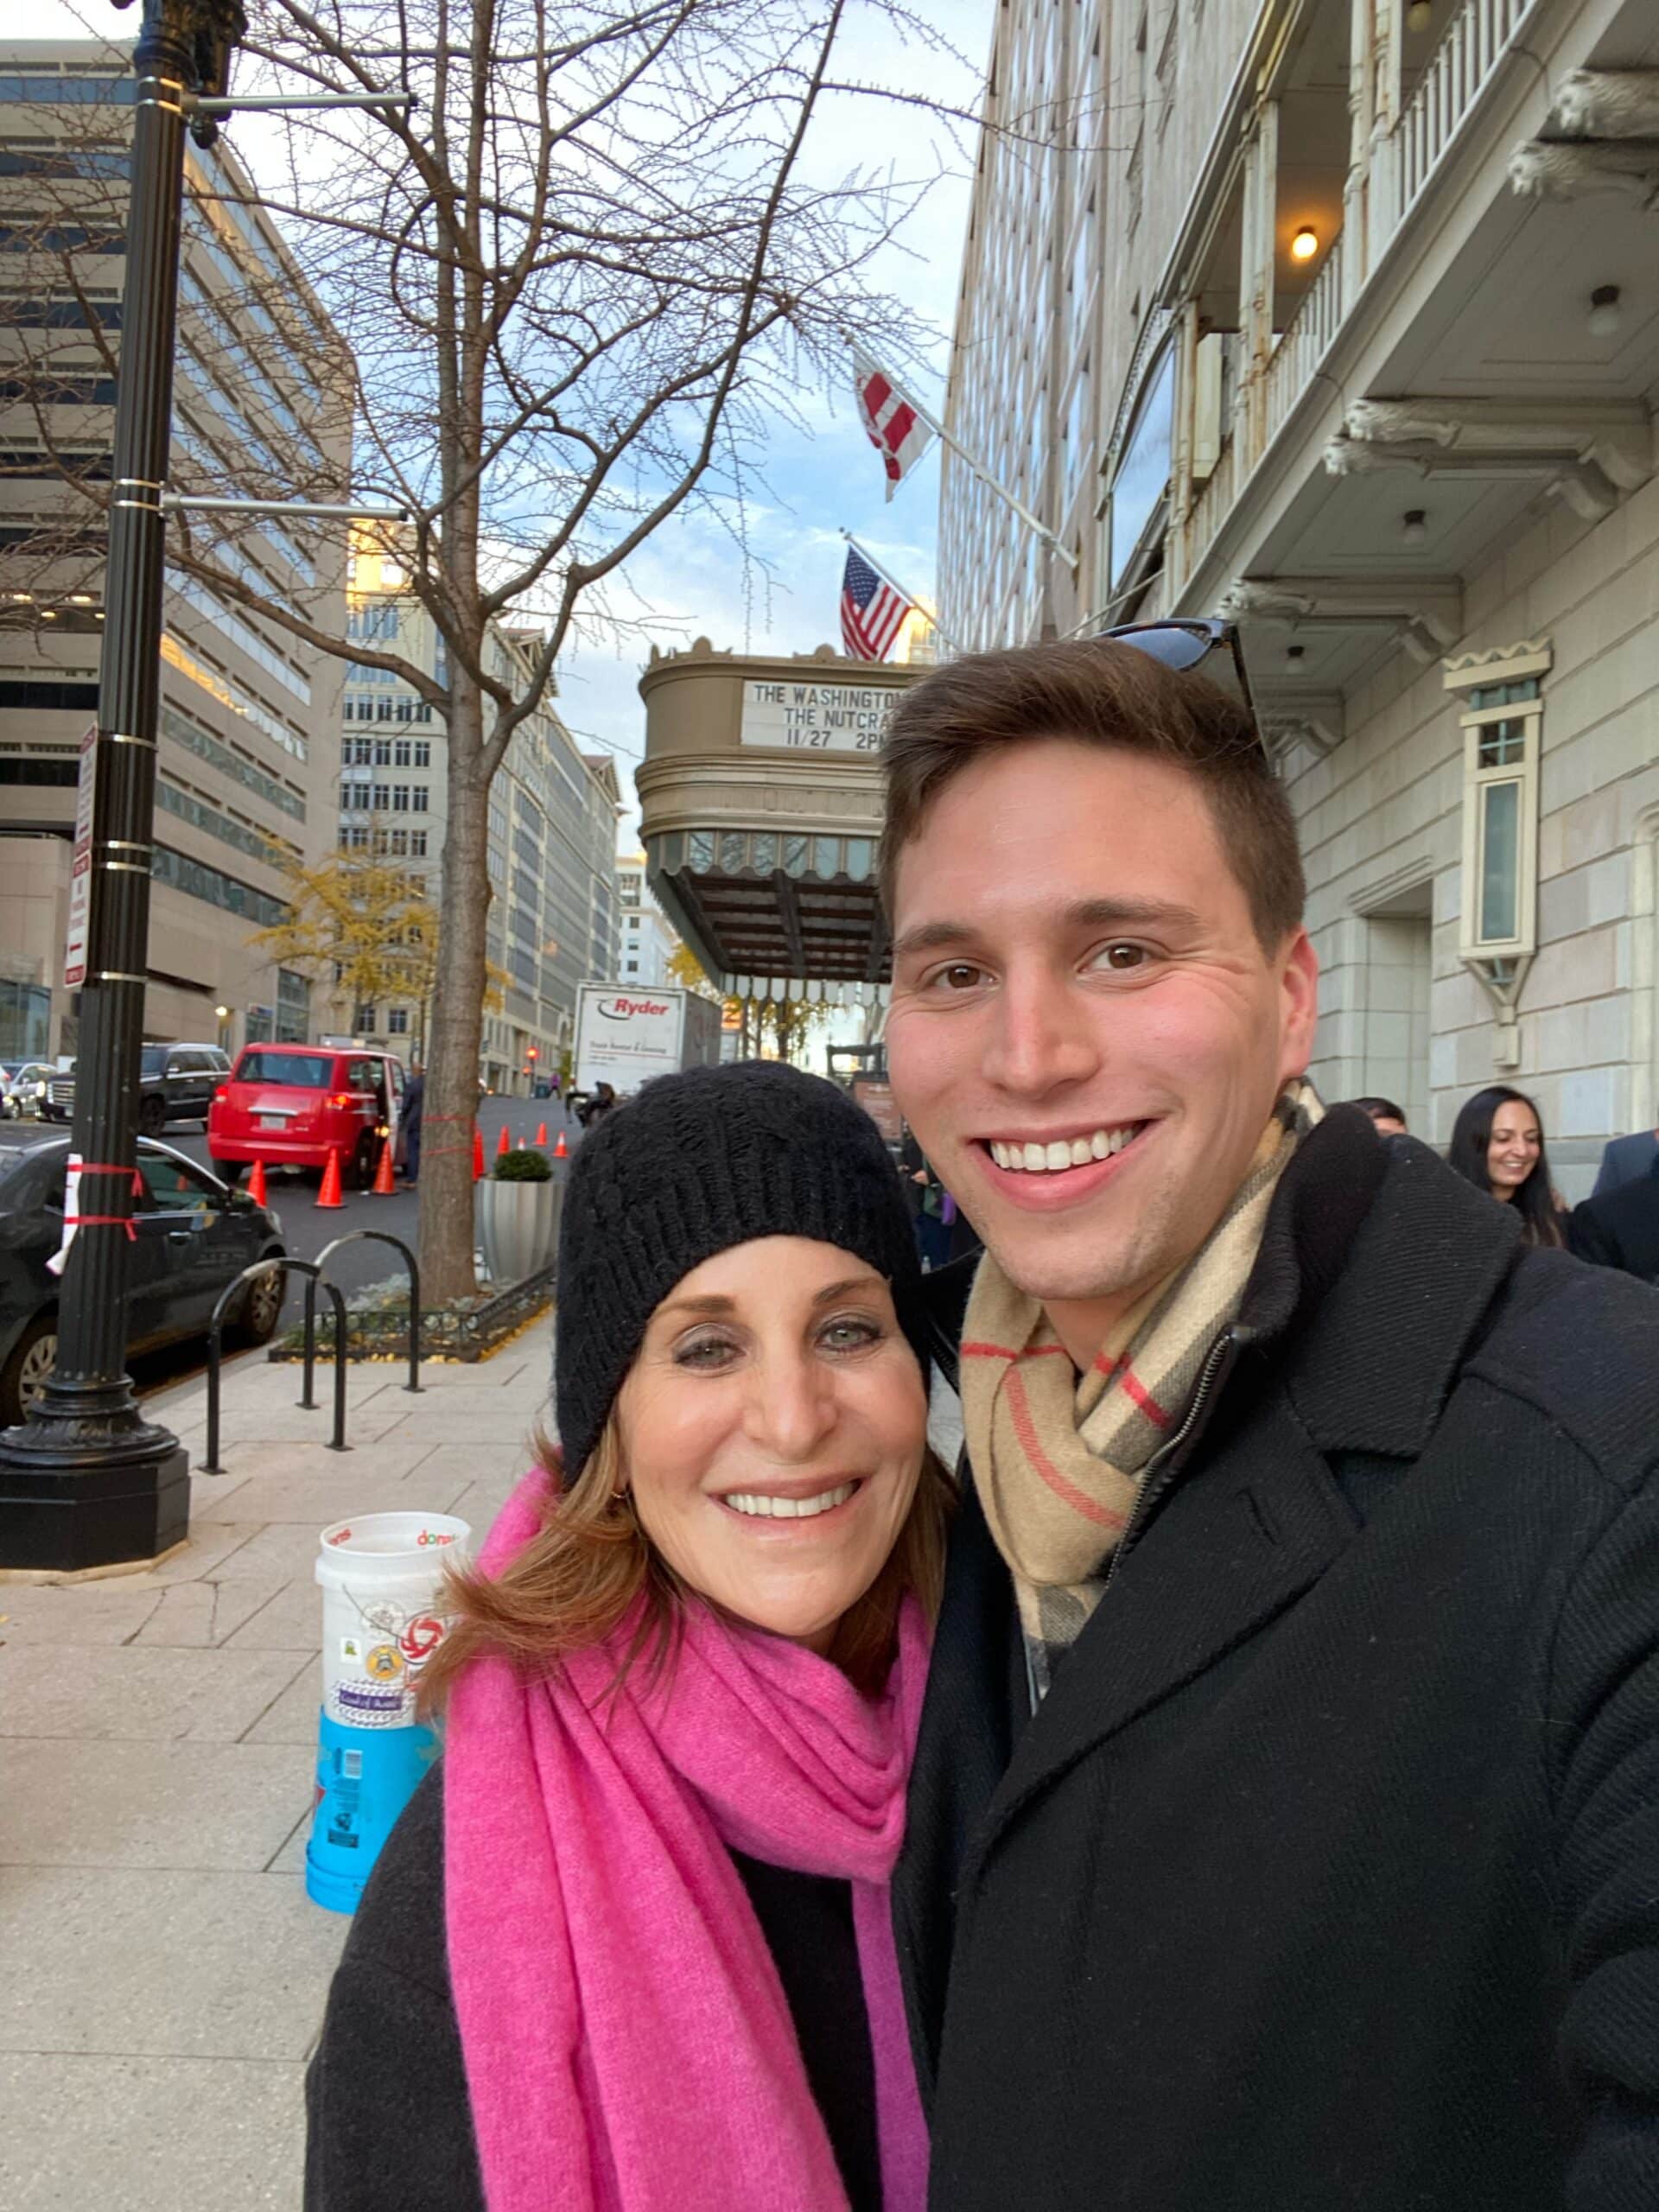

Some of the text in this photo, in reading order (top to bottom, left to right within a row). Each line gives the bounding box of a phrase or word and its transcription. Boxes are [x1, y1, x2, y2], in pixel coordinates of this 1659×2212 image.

[754, 685, 785, 703] THE
[785, 708, 816, 726] THE
[787, 728, 831, 747] 11/27
[614, 998, 670, 1016] Ryder
